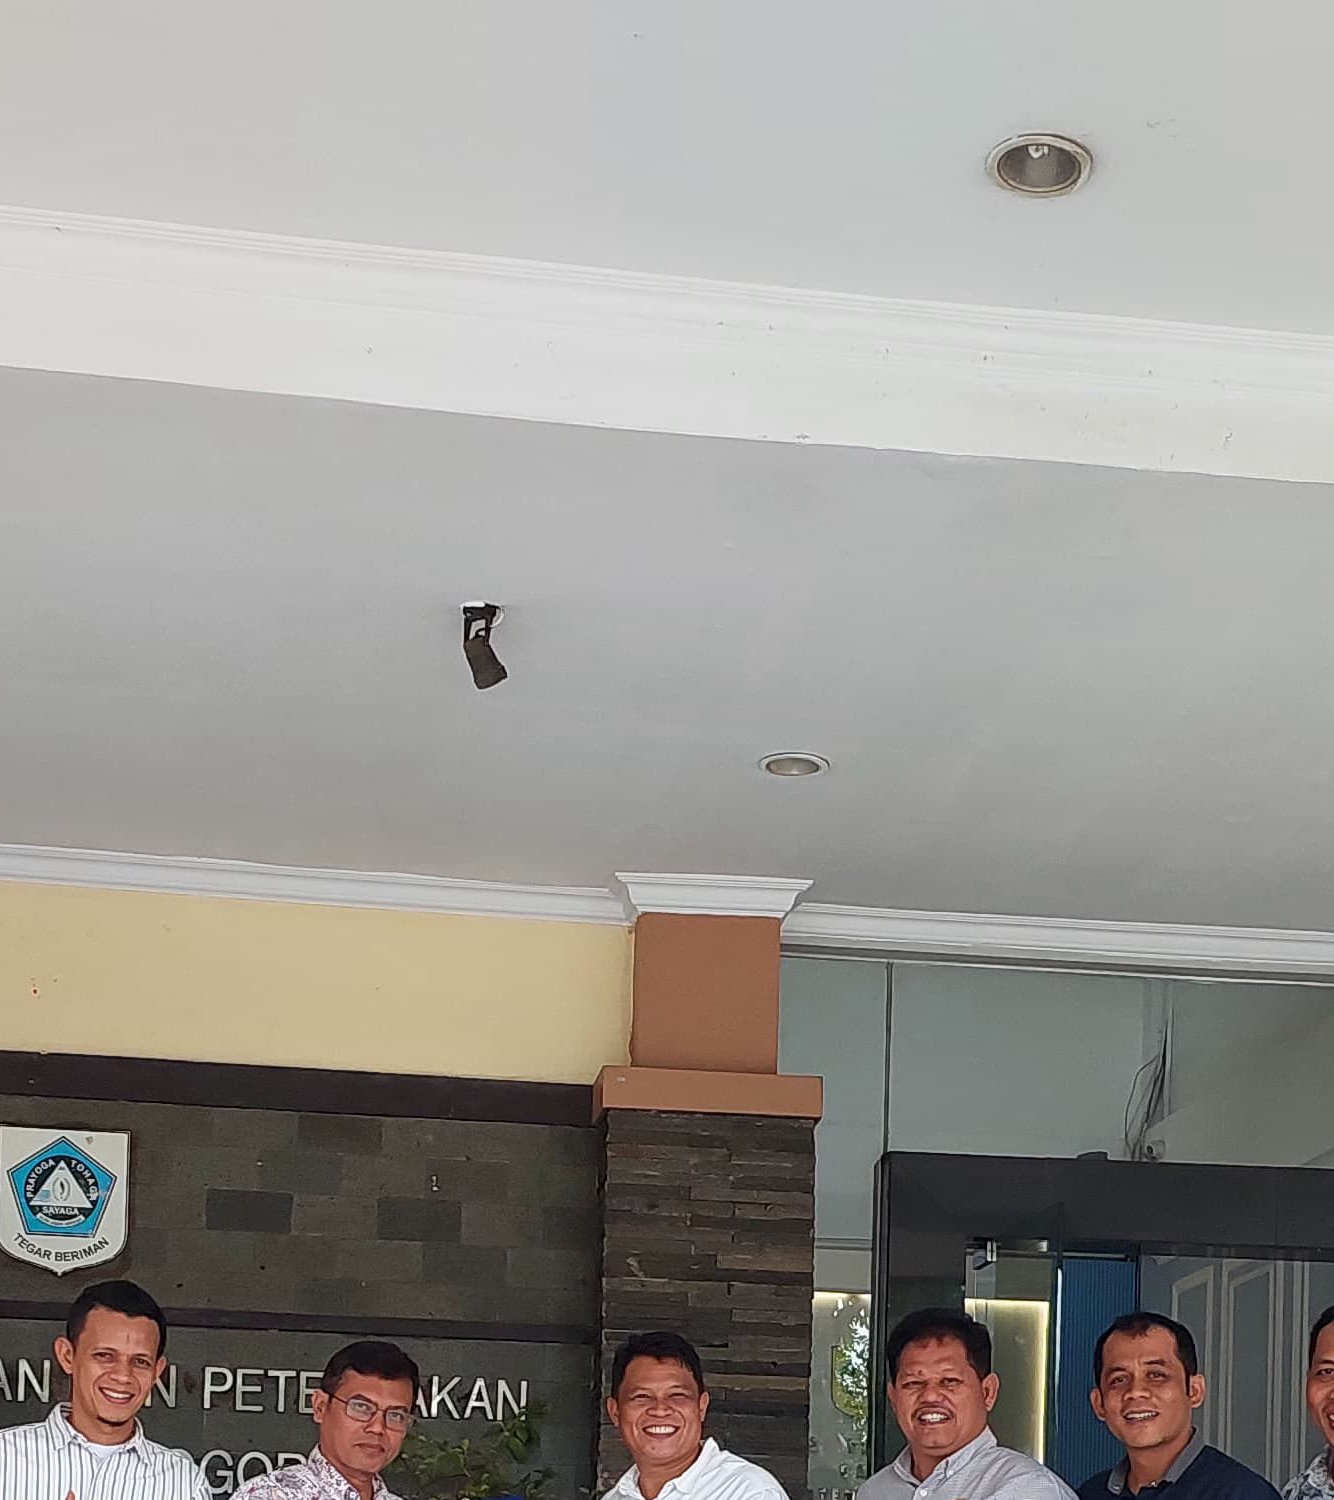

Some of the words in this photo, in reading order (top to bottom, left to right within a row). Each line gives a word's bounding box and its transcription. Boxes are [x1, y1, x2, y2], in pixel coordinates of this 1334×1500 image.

[26, 1158, 56, 1198] PRAYOGA
[71, 1159, 98, 1200] TOHAGA
[42, 1206, 79, 1216] SAYAGA
[13, 1233, 51, 1261] TEGAR
[54, 1237, 109, 1262] BERIMAN
